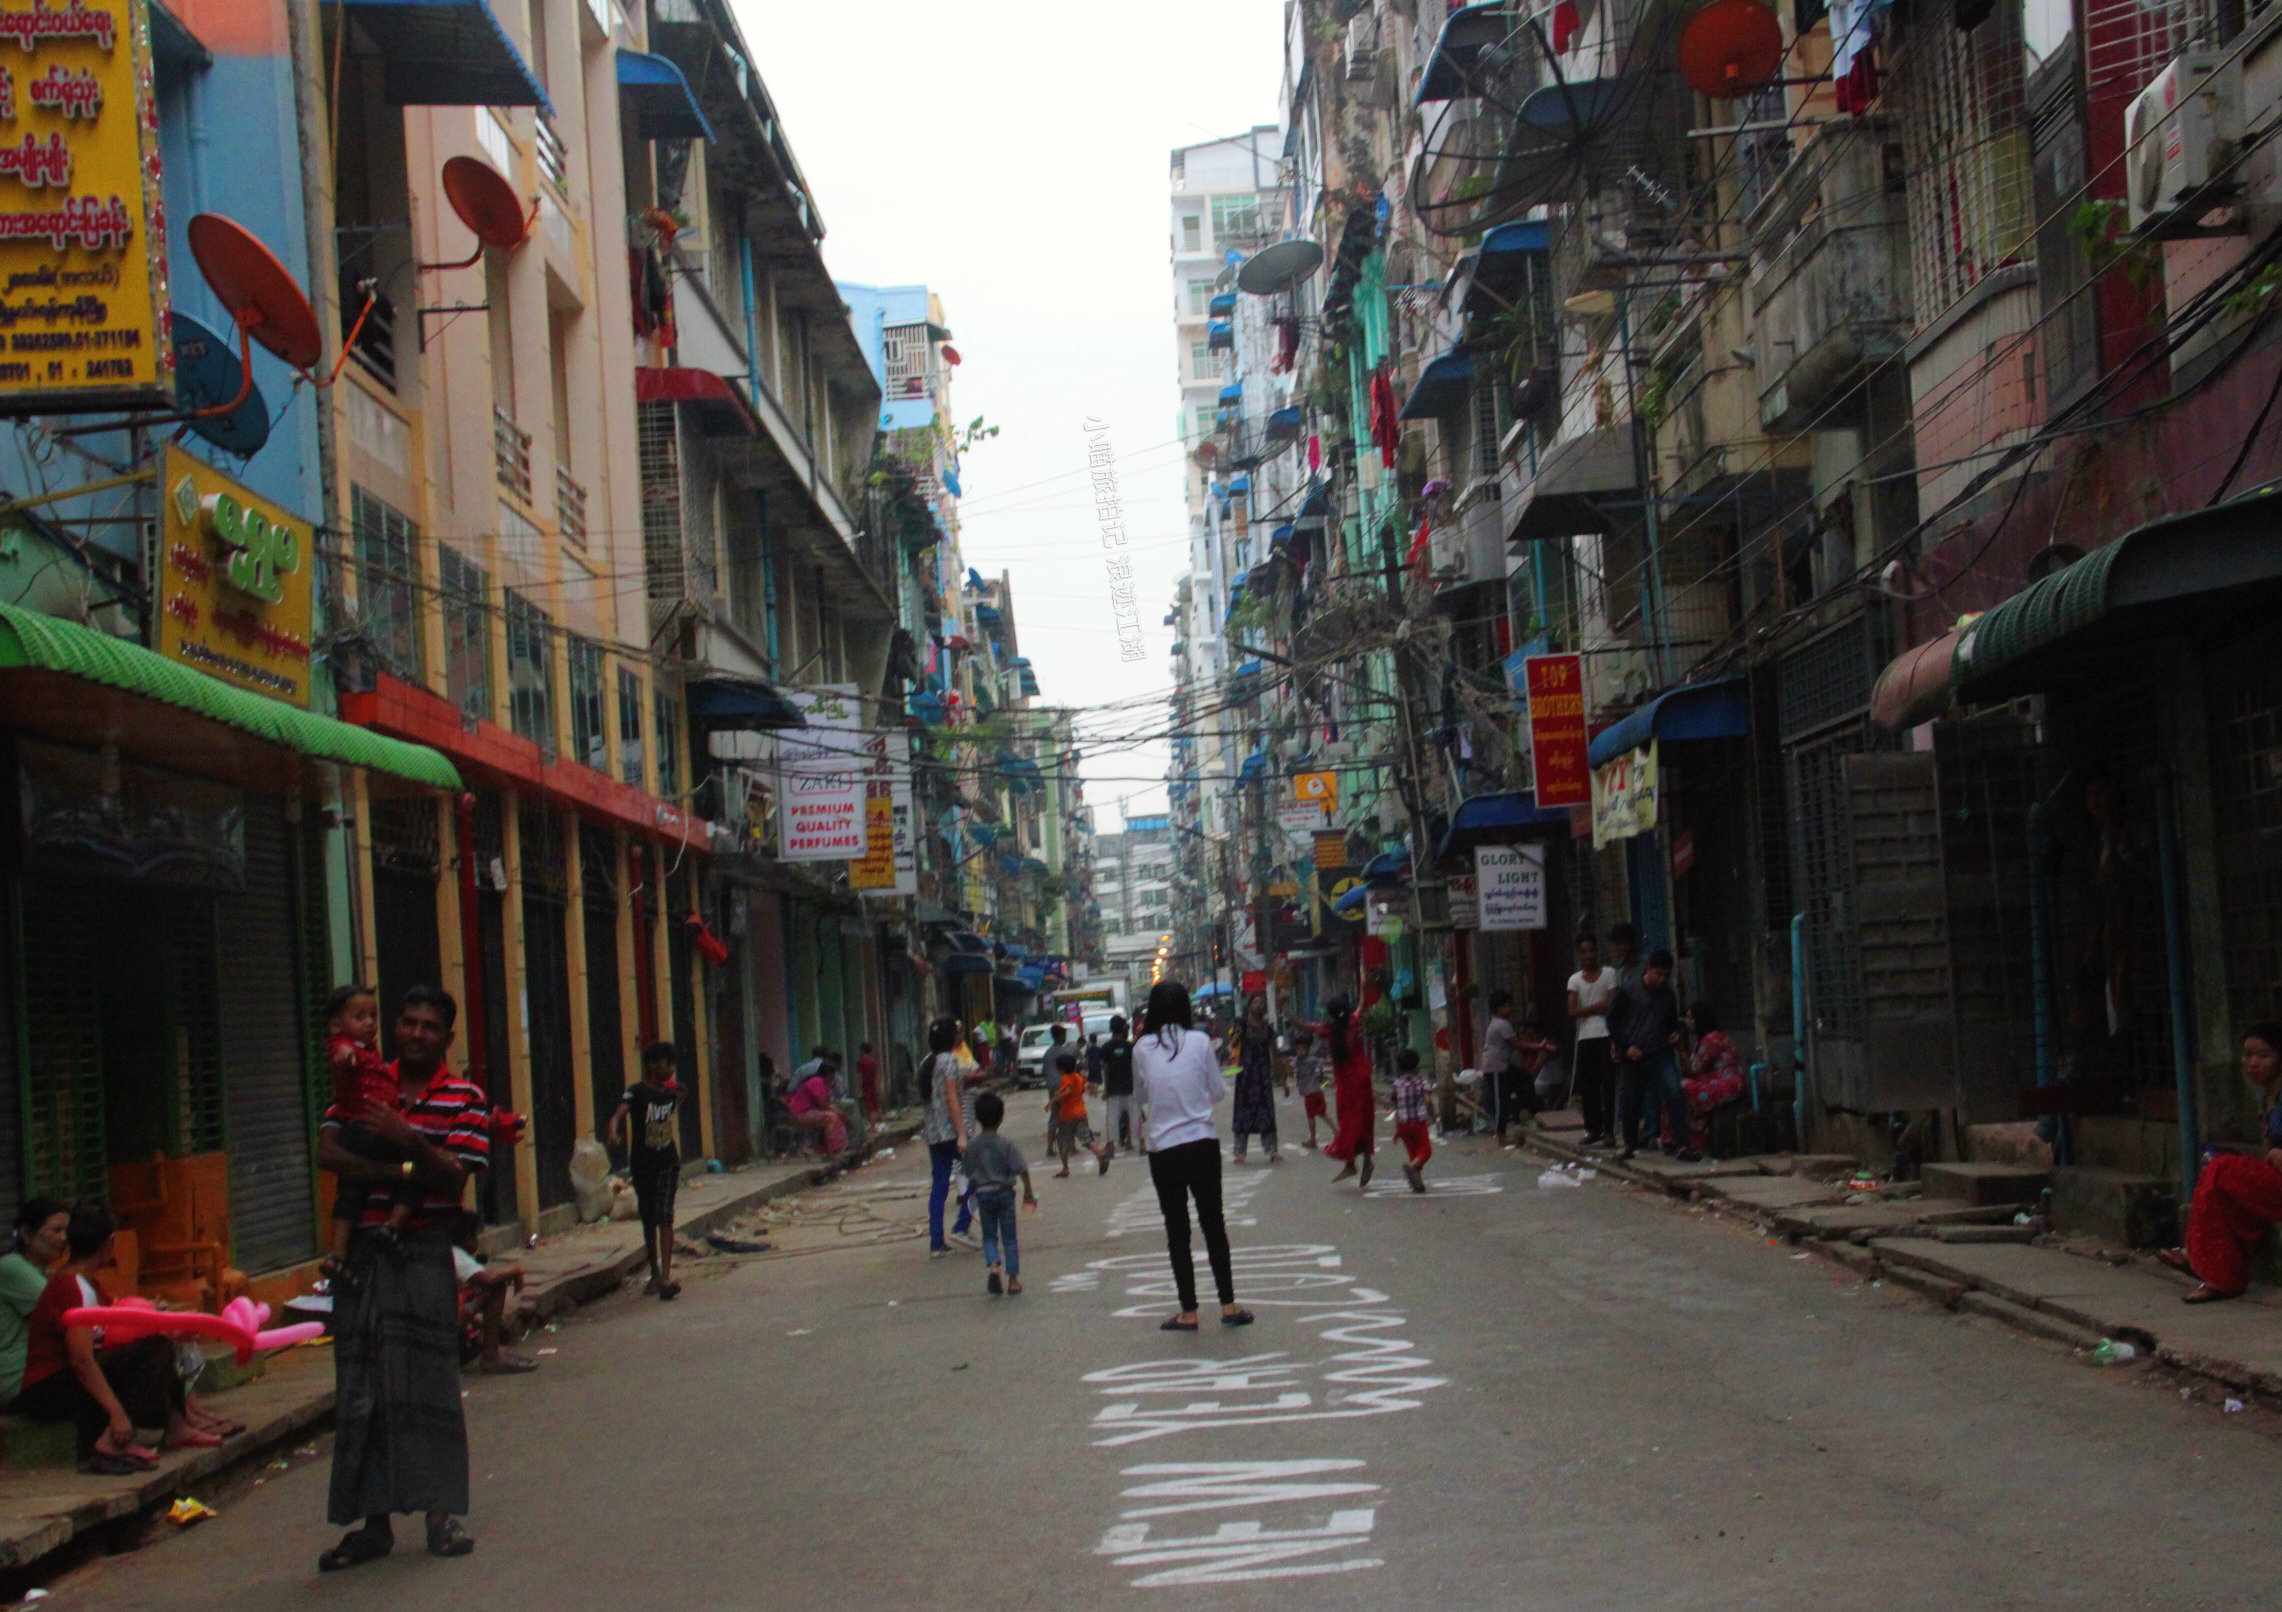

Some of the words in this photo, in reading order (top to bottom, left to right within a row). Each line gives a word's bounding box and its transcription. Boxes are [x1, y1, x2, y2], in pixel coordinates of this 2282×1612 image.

[791, 803, 855, 816] PREMIUM
[796, 819, 852, 832] QUALITY
[790, 835, 859, 849] PERFUMES
[1480, 853, 1525, 866] GLORY
[1497, 872, 1538, 884] LIGHT
